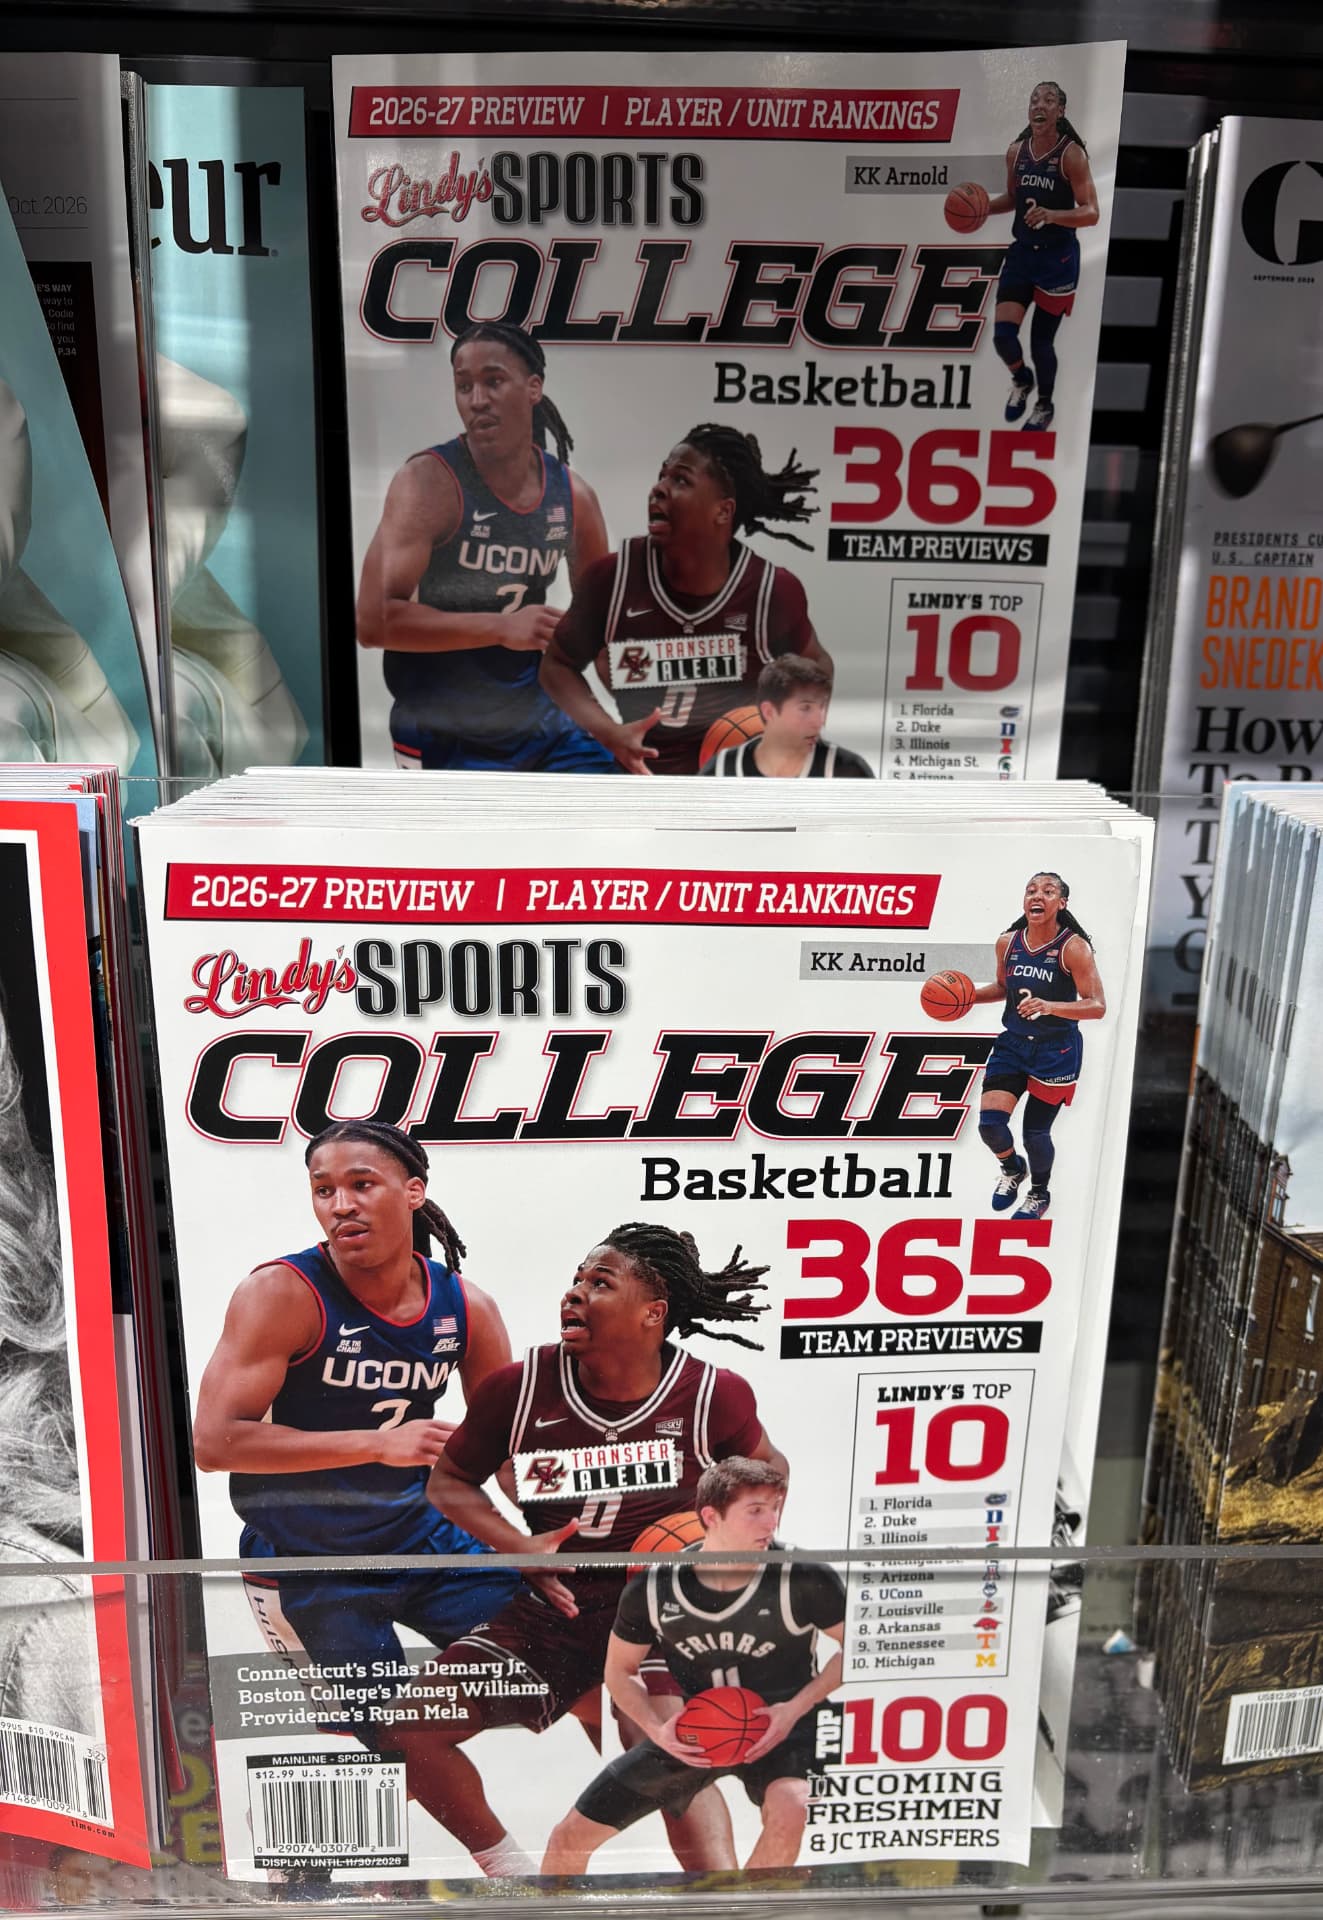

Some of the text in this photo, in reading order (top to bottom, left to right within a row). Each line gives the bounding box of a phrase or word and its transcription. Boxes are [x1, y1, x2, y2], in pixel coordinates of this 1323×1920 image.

[369, 96, 465, 126] 2026-27
[468, 96, 587, 126] PREVIEW
[624, 97, 723, 127] PLAYER
[745, 98, 807, 128] UNIT
[809, 99, 940, 131] RANKINGS
[853, 166, 948, 186] KK Arnold
[361, 151, 704, 227] Lindy's SPORTS
[43, 196, 88, 214] 2026
[359, 237, 1009, 353] COLLEGE
[713, 361, 972, 410] Basketball
[830, 426, 1057, 527] 365
[844, 535, 1033, 562] TEAM PREVIEWS
[1213, 531, 1299, 547] PRESIDENTS
[1212, 552, 1314, 566] U.S. CAPTAIN
[908, 593, 1024, 612] LINDY'S TOP
[655, 638, 736, 660] TRANSFER
[905, 614, 1022, 693] 10
[661, 658, 733, 682] ALERT
[900, 703, 954, 717] 1. Florida
[896, 720, 941, 733] 2. Duke
[895, 738, 951, 750] 3. Illinois
[894, 755, 980, 770] 4. Michigan St.
[191, 875, 318, 908] 2026-27
[322, 877, 475, 912] PREVIEW
[526, 879, 649, 911] PLAYER
[678, 881, 753, 912] UNIT
[756, 882, 916, 916] RANKINGS
[810, 952, 926, 974] KK Arnold
[184, 936, 627, 1019] Lindy's SPORTS
[185, 1030, 1001, 1145] COLLEGE
[640, 1153, 953, 1202] Basketball
[784, 1218, 1053, 1319] 365
[800, 1326, 1023, 1355] TEAM PREVIEWS
[877, 1383, 1011, 1403] LINDY'S TOP
[572, 1442, 670, 1469] TRANSFER
[875, 1404, 1010, 1485] 10
[579, 1463, 668, 1491] ALERT
[869, 1496, 933, 1511] 1. Florida
[864, 1514, 917, 1528] 2. Duke
[863, 1531, 928, 1546] 3. Illinois
[862, 1570, 935, 1585] 5. Arizona
[861, 1587, 923, 1601] 6. UConn
[860, 1603, 944, 1619] 7. Louisville
[858, 1621, 941, 1635] 8. Arkansas
[675, 1631, 777, 1661] FRIARS
[858, 1637, 945, 1653] 9. Tennessee
[237, 1658, 528, 1683] Connecticut's Silas Demary Jr.
[852, 1655, 935, 1671] 10. Michigan
[238, 1679, 549, 1706] Boston College's Money Williams
[239, 1703, 469, 1728] Providence's Ryan Mela
[815, 1694, 1008, 1765] TOP 100
[271, 1753, 382, 1766] MAINLINE SPORTS
[255, 1767, 400, 1779] $12.99 U.S. $15.99 CAN
[379, 1779, 396, 1788] 63
[808, 1771, 1003, 1799] INCOMING
[806, 1799, 1003, 1825] FRESHMEN
[71, 1819, 116, 1838] time.com
[278, 1843, 315, 1854] 29074
[321, 1843, 358, 1854] 03078
[810, 1828, 1000, 1855] & JC TRANSFERS
[262, 1858, 311, 1868] DISPLAY
[312, 1857, 342, 1868] UNTIL
